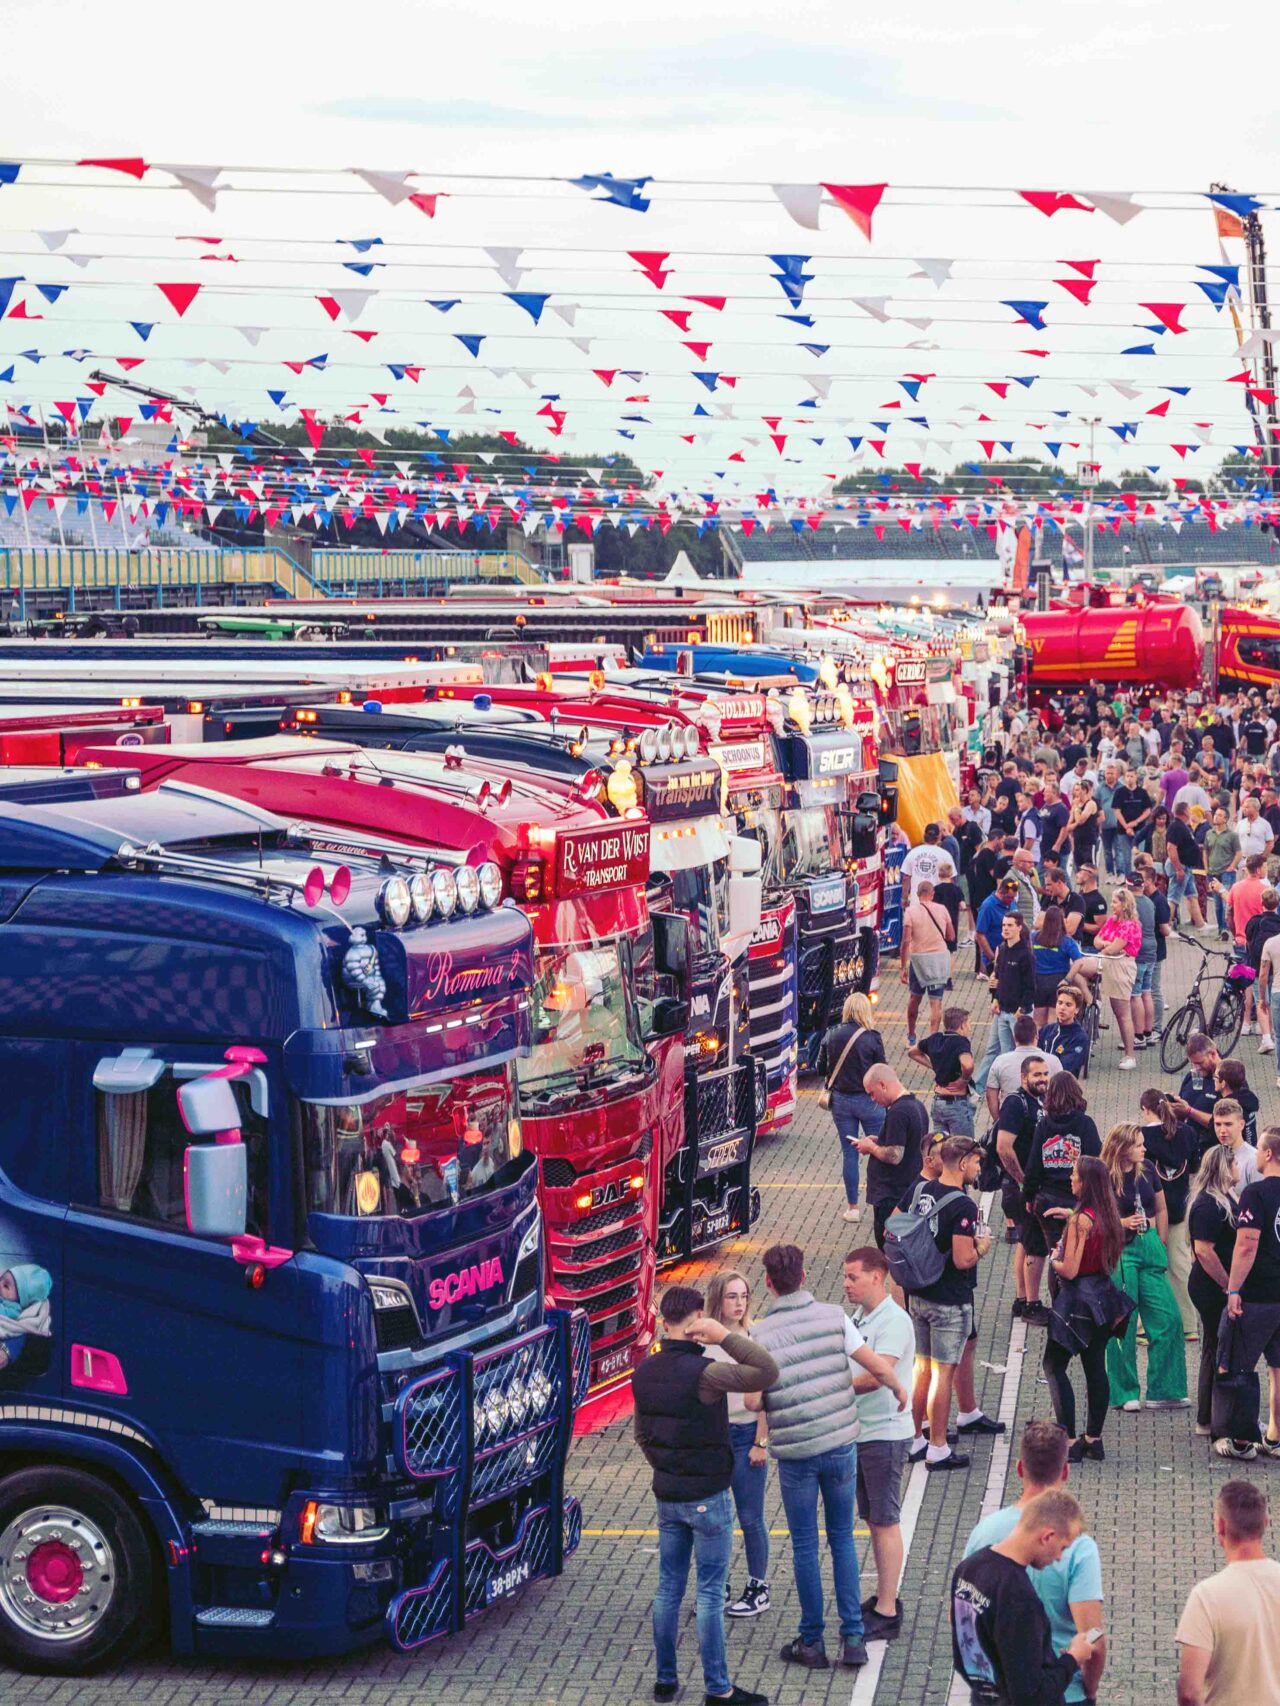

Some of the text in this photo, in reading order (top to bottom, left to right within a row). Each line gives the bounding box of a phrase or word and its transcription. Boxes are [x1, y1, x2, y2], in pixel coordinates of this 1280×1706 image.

[720, 700, 763, 719] HOLLAND
[655, 784, 713, 808] transport
[577, 841, 599, 865] VAN
[601, 839, 620, 861] DER
[585, 864, 628, 887] TRANSPORT
[421, 949, 520, 1007] Romina 2
[591, 1176, 631, 1210] DAF
[428, 1256, 504, 1310] SCANIA
